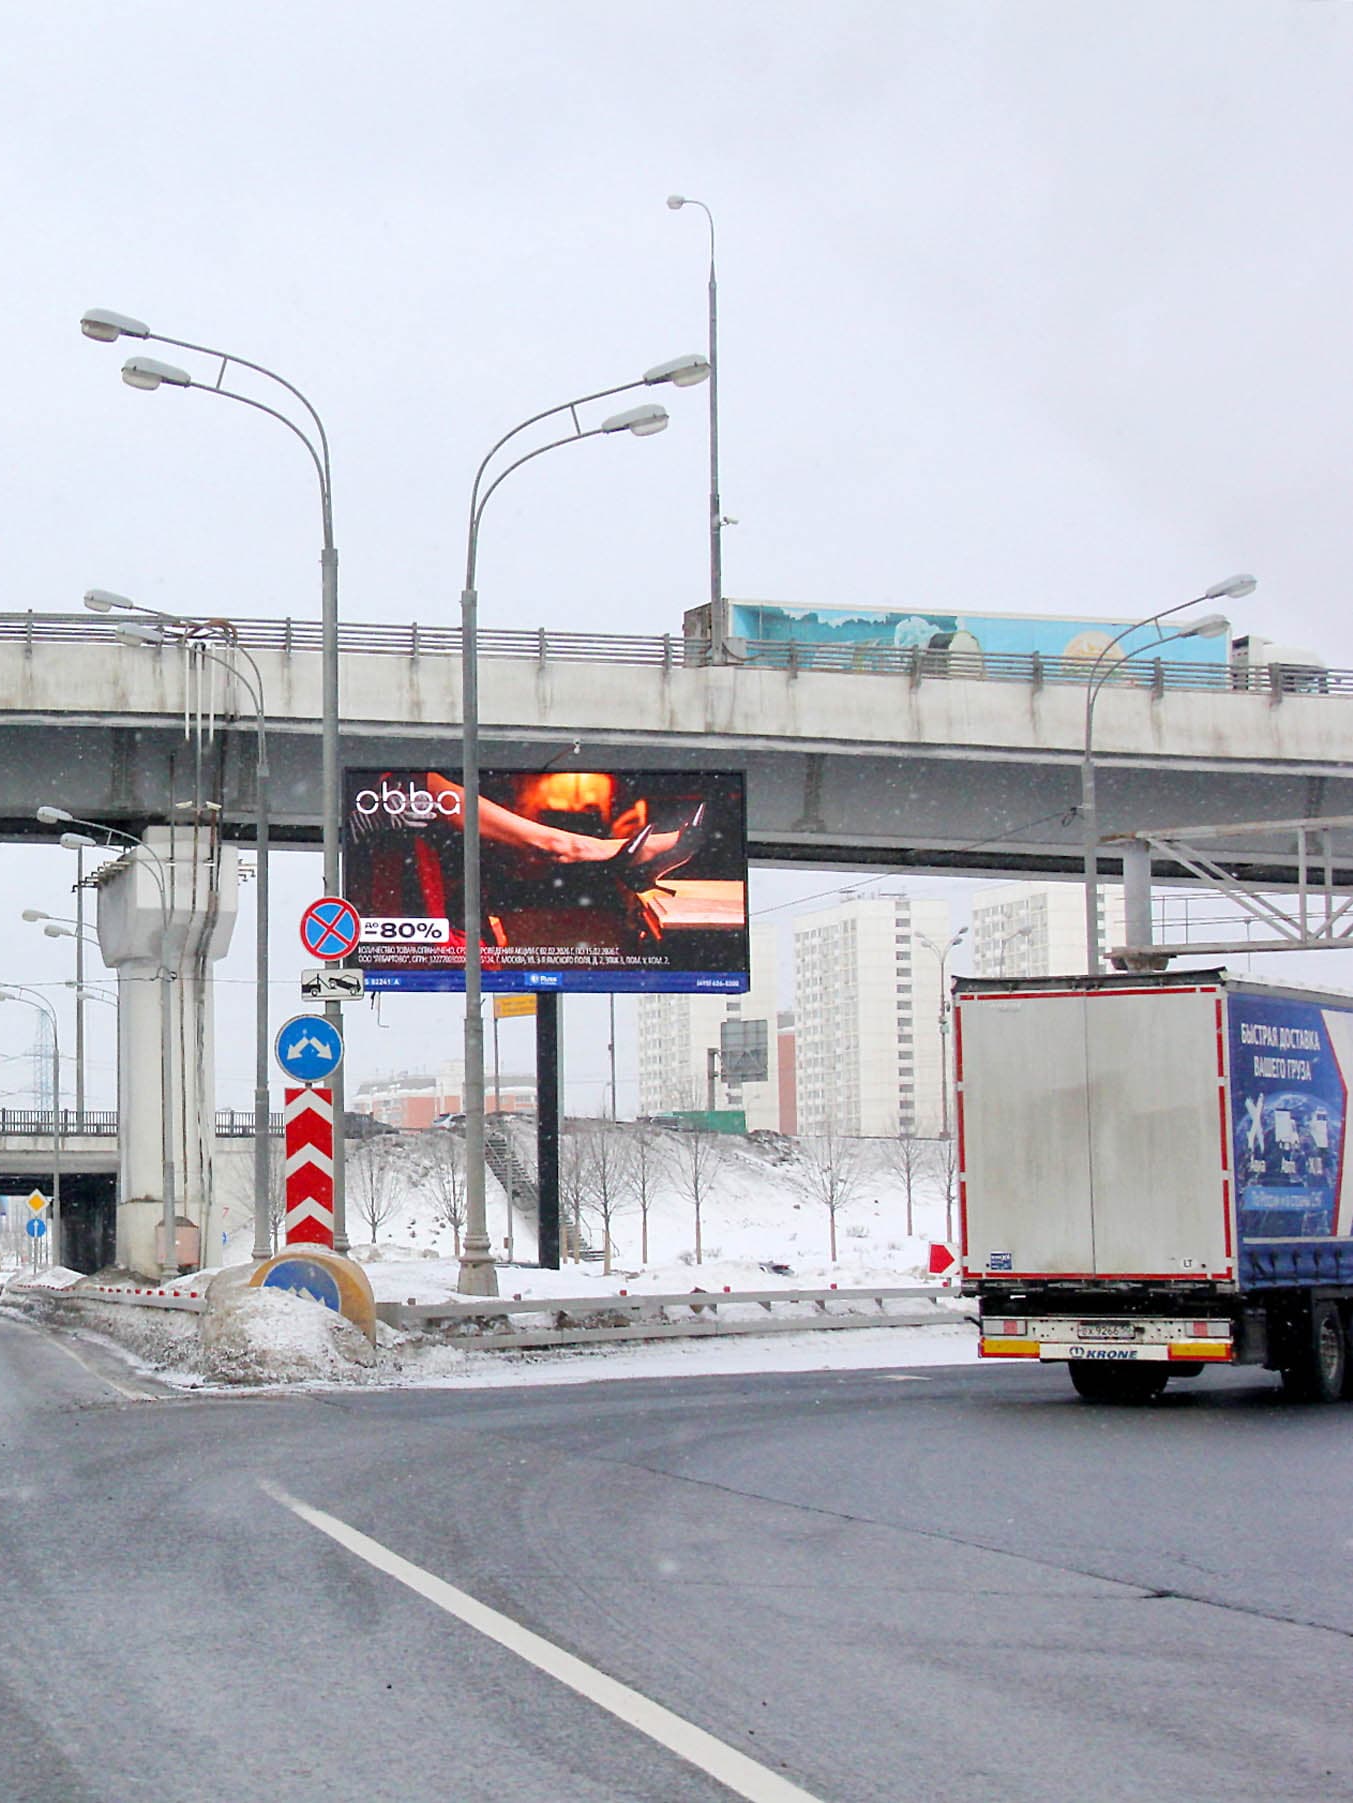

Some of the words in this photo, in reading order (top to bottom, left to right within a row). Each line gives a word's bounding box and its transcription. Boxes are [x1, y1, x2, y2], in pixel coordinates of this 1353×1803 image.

[356, 781, 461, 815] obba
[364, 922, 443, 939] -80%
[1240, 1023, 1277, 1048] БЫСТРАЯ
[1279, 1027, 1321, 1051] ДОСТАВКА
[1253, 1055, 1286, 1079] ВАШЕГО
[1287, 1059, 1312, 1081] ГРУЗА
[1086, 1350, 1138, 1359] KRONE
